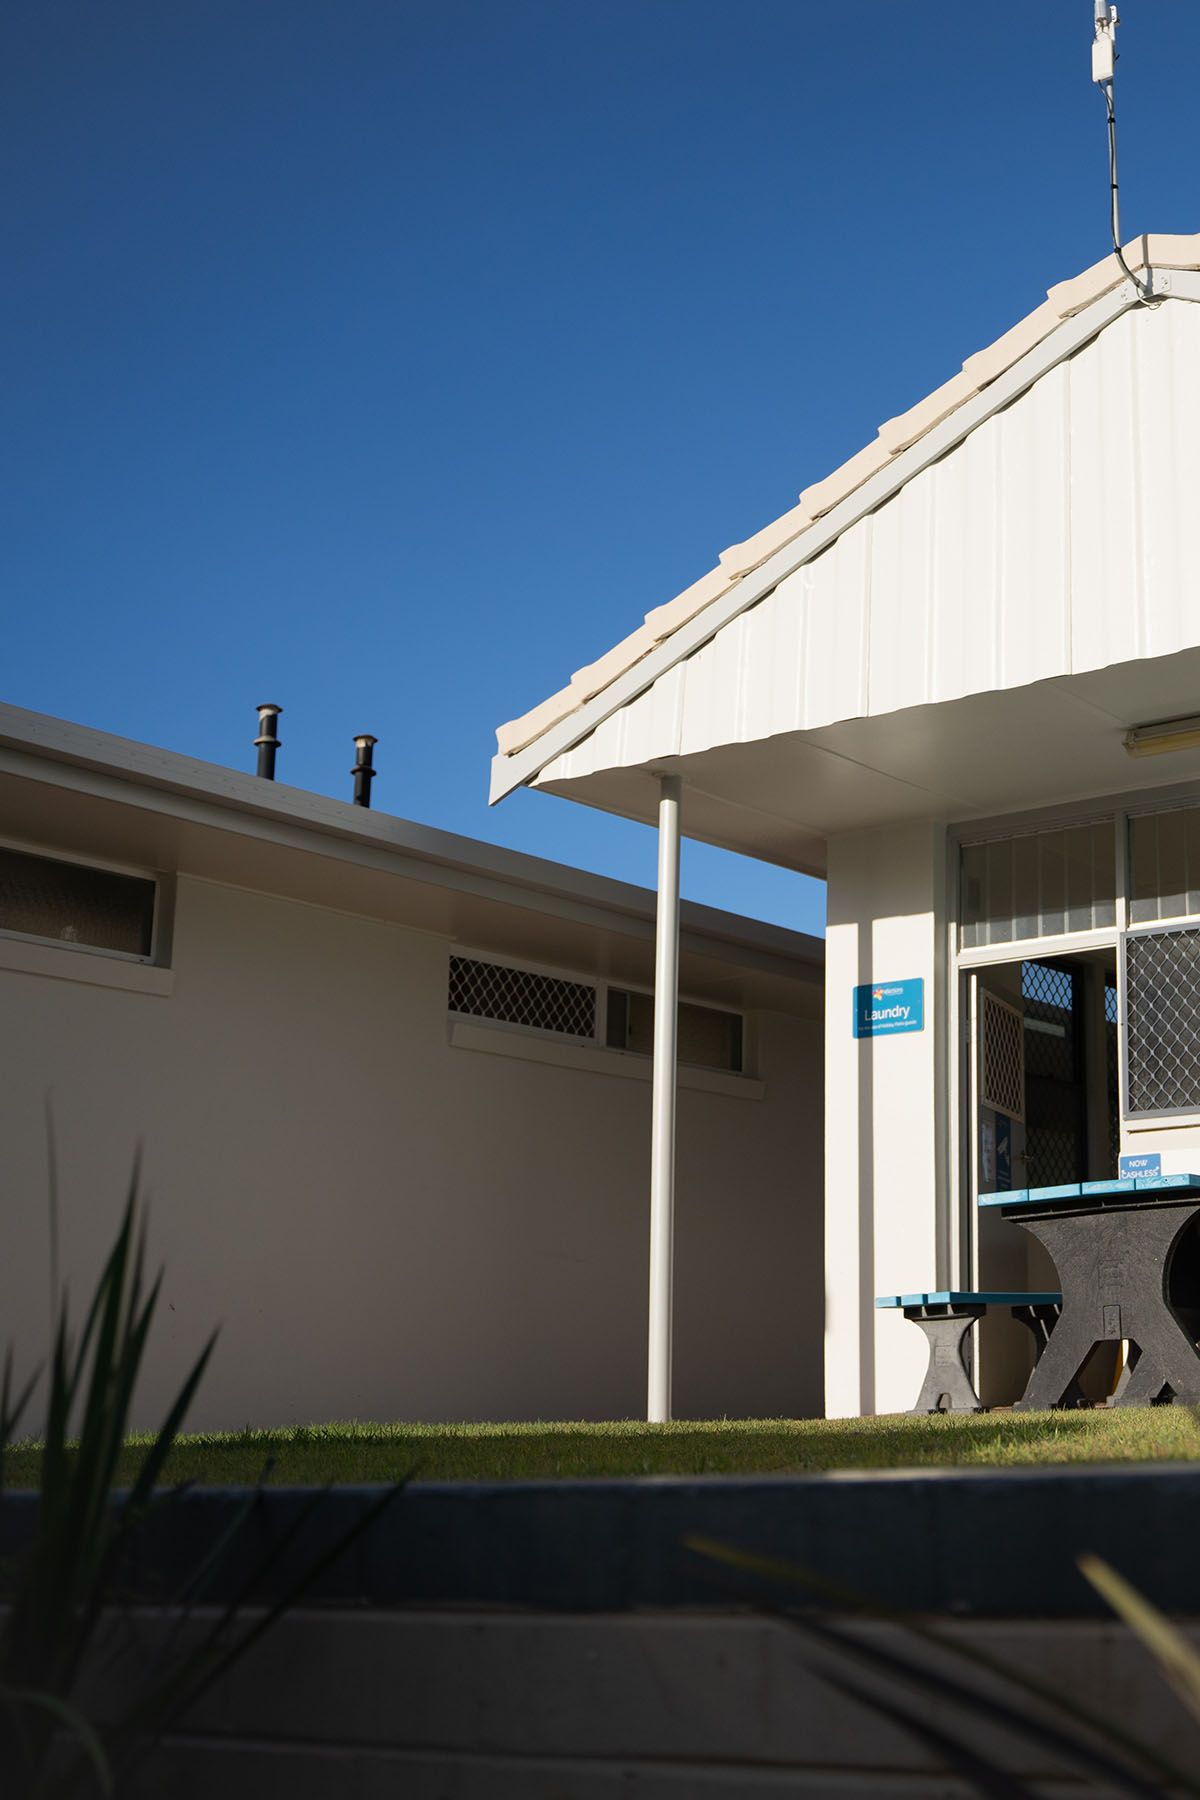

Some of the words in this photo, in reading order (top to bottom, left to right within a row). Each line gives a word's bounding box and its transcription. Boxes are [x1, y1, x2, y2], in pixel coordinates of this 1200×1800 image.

[864, 1004, 911, 1021] Laundry
[1129, 1160, 1148, 1168] NOW
[1122, 1169, 1158, 1179] CASHLESS
